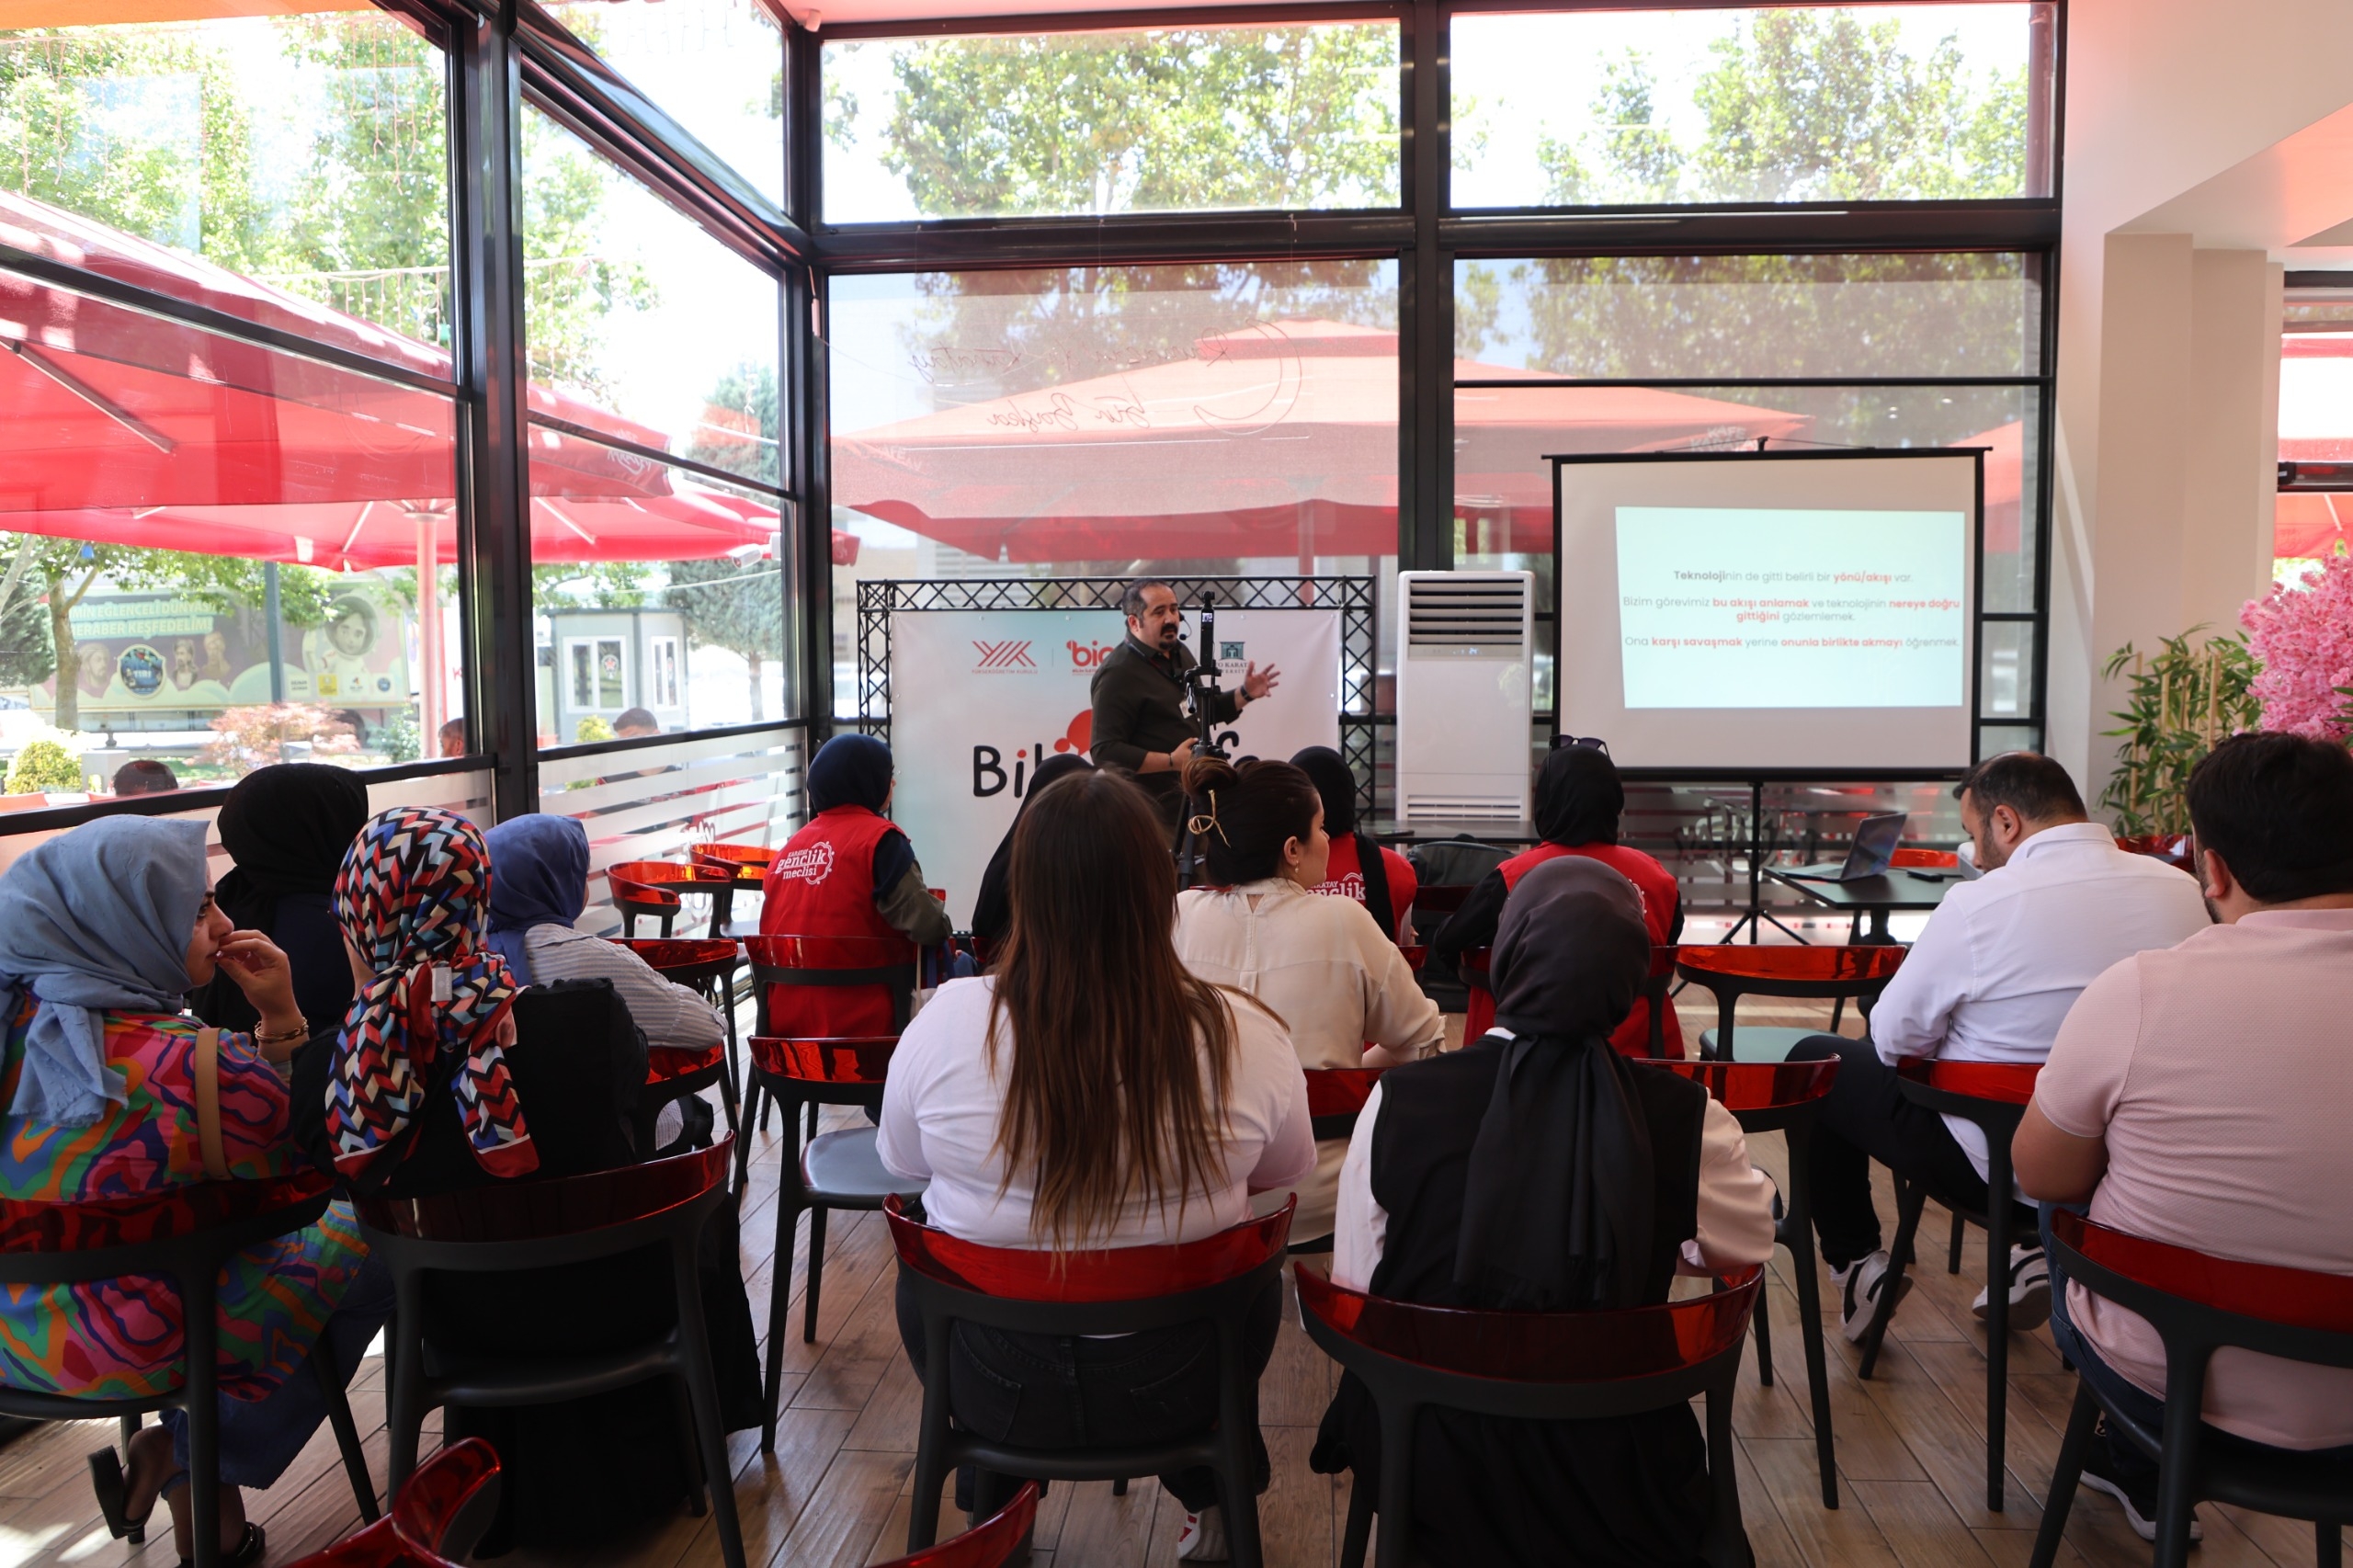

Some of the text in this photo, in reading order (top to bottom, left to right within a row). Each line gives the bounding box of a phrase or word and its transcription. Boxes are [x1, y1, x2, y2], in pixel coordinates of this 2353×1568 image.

[1674, 571, 1914, 585] Teknolojinin de gitti belirli bir yönü/akışı var.
[97, 600, 160, 618] EĞLENCELİ
[1623, 597, 1653, 607] Bizim
[1655, 597, 1710, 609] görevimiz
[1712, 598, 1727, 608] bu
[1730, 598, 1757, 609] akışı
[1759, 598, 1809, 608] anlamak
[1826, 599, 1886, 610] teknolojinin
[1889, 600, 1926, 610] nereye
[1928, 599, 1960, 611] doğru
[1736, 610, 1856, 623] gittiğini gözlemlemek.
[129, 616, 212, 636] KEŞFEDELİM!
[1624, 636, 1960, 649] Ona karşı savaşmak yerine onunla birlikte akmayı öğrenmek.
[782, 864, 817, 881] meclisi
